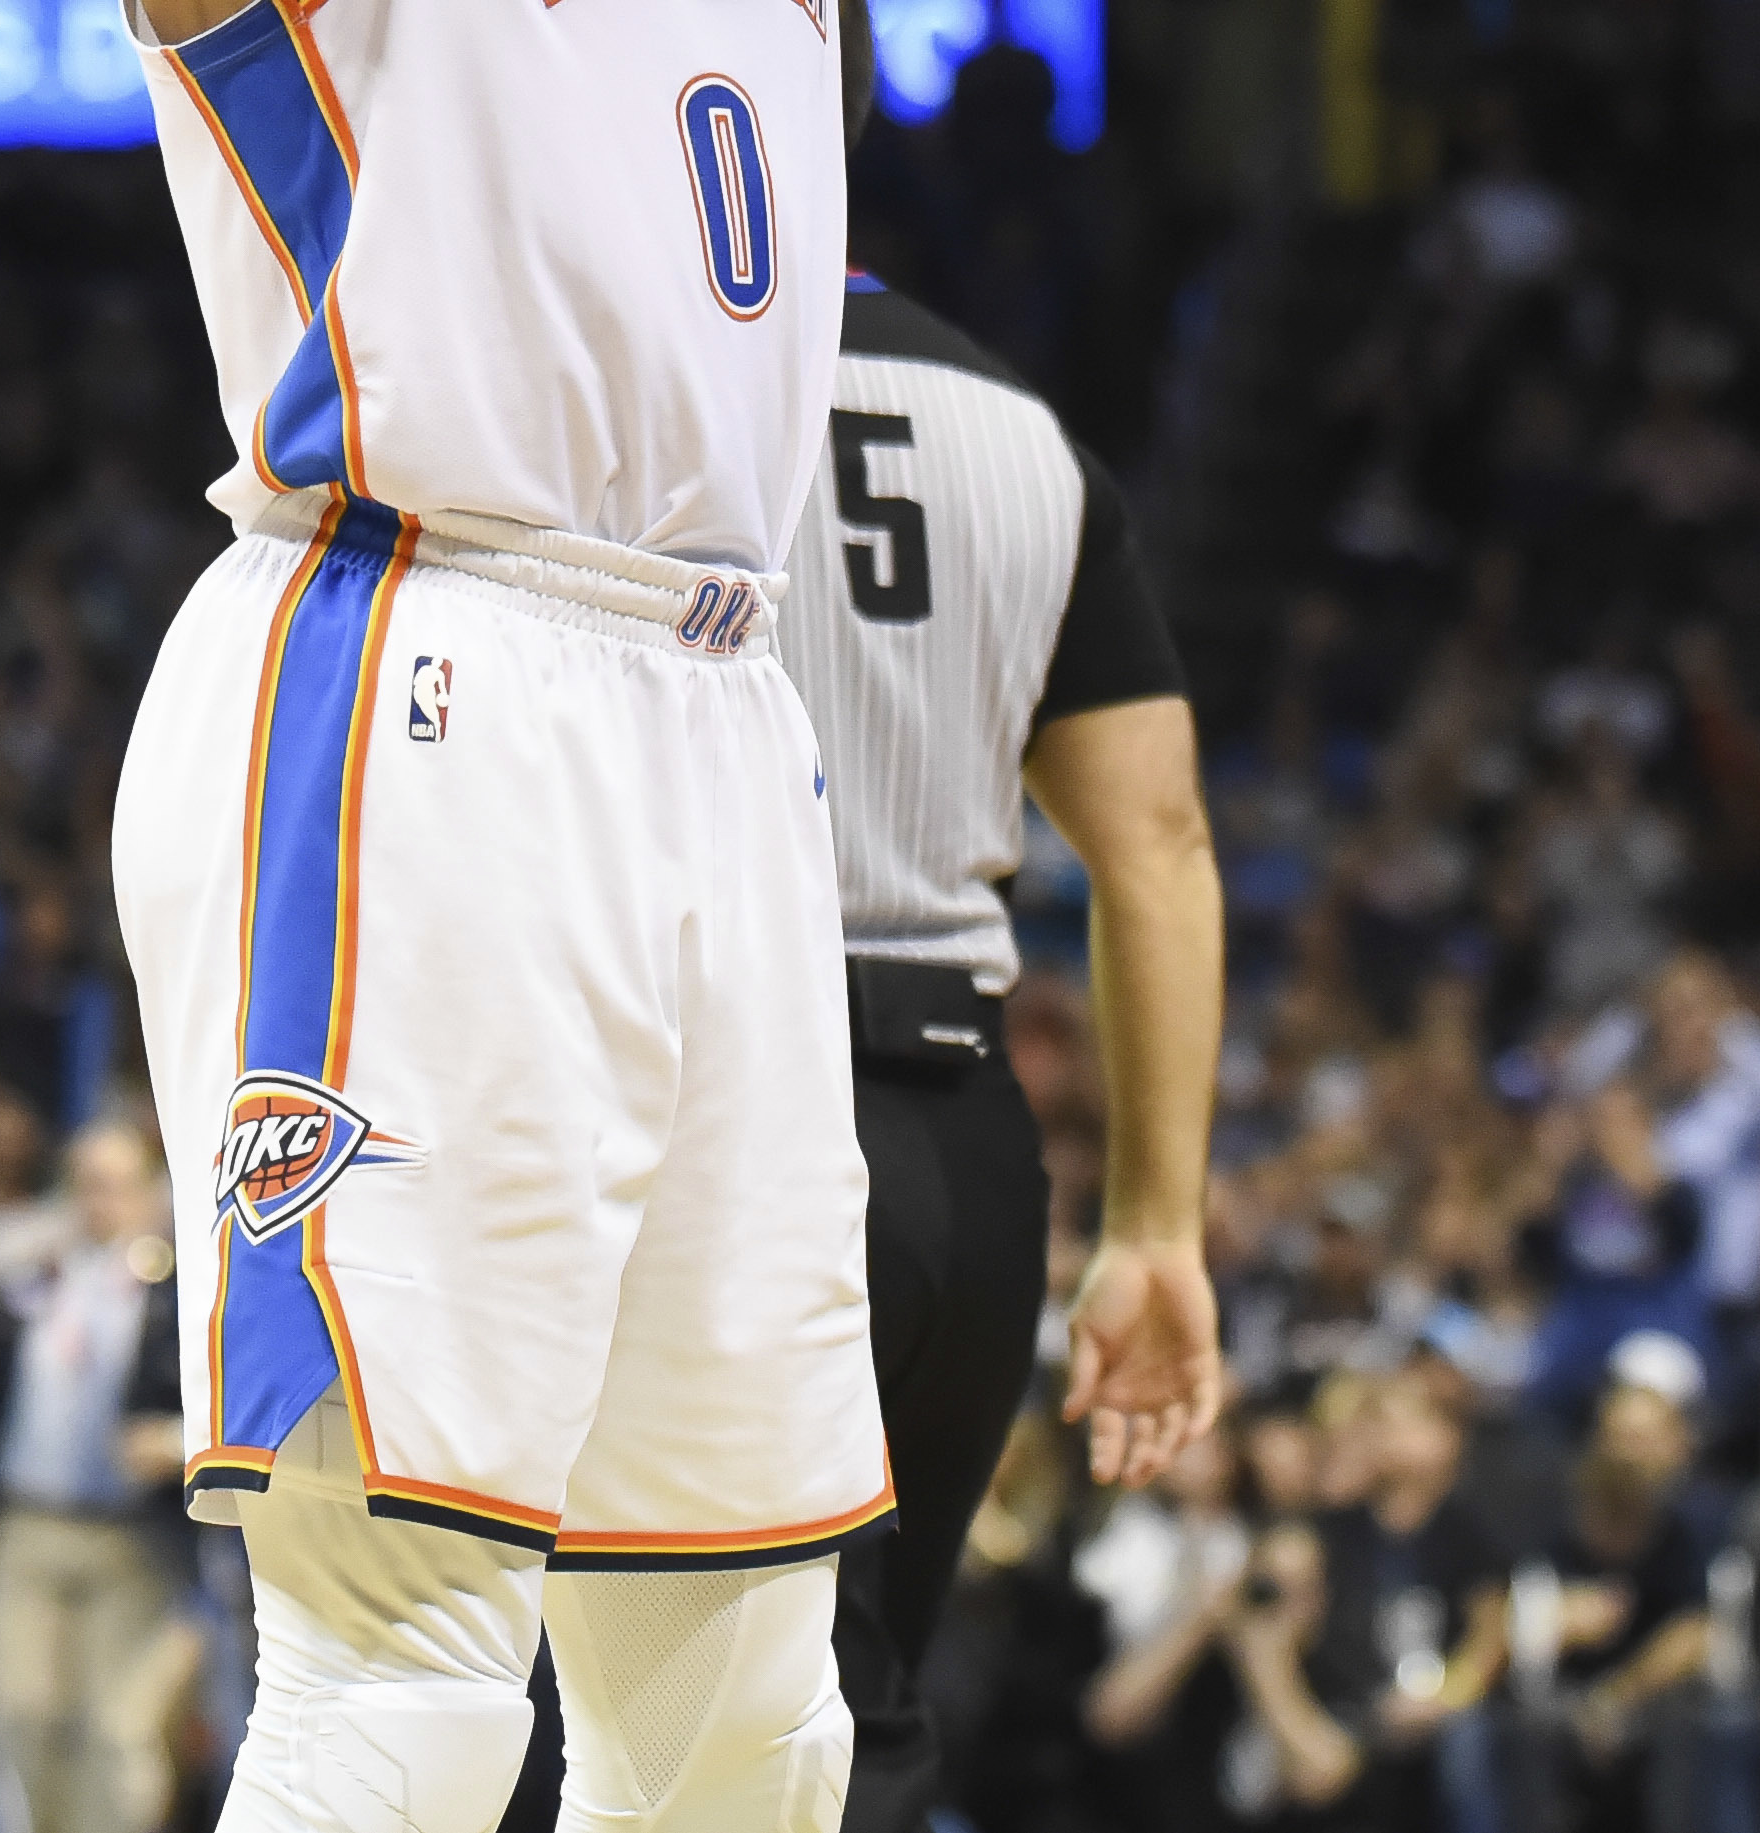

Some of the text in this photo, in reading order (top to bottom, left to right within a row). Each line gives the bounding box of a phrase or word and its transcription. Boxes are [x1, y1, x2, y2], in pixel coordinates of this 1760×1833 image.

[675, 72, 778, 322] 0
[829, 406, 933, 626] 5
[411, 723, 435, 738] NBA
[217, 1113, 329, 1204] OKC
